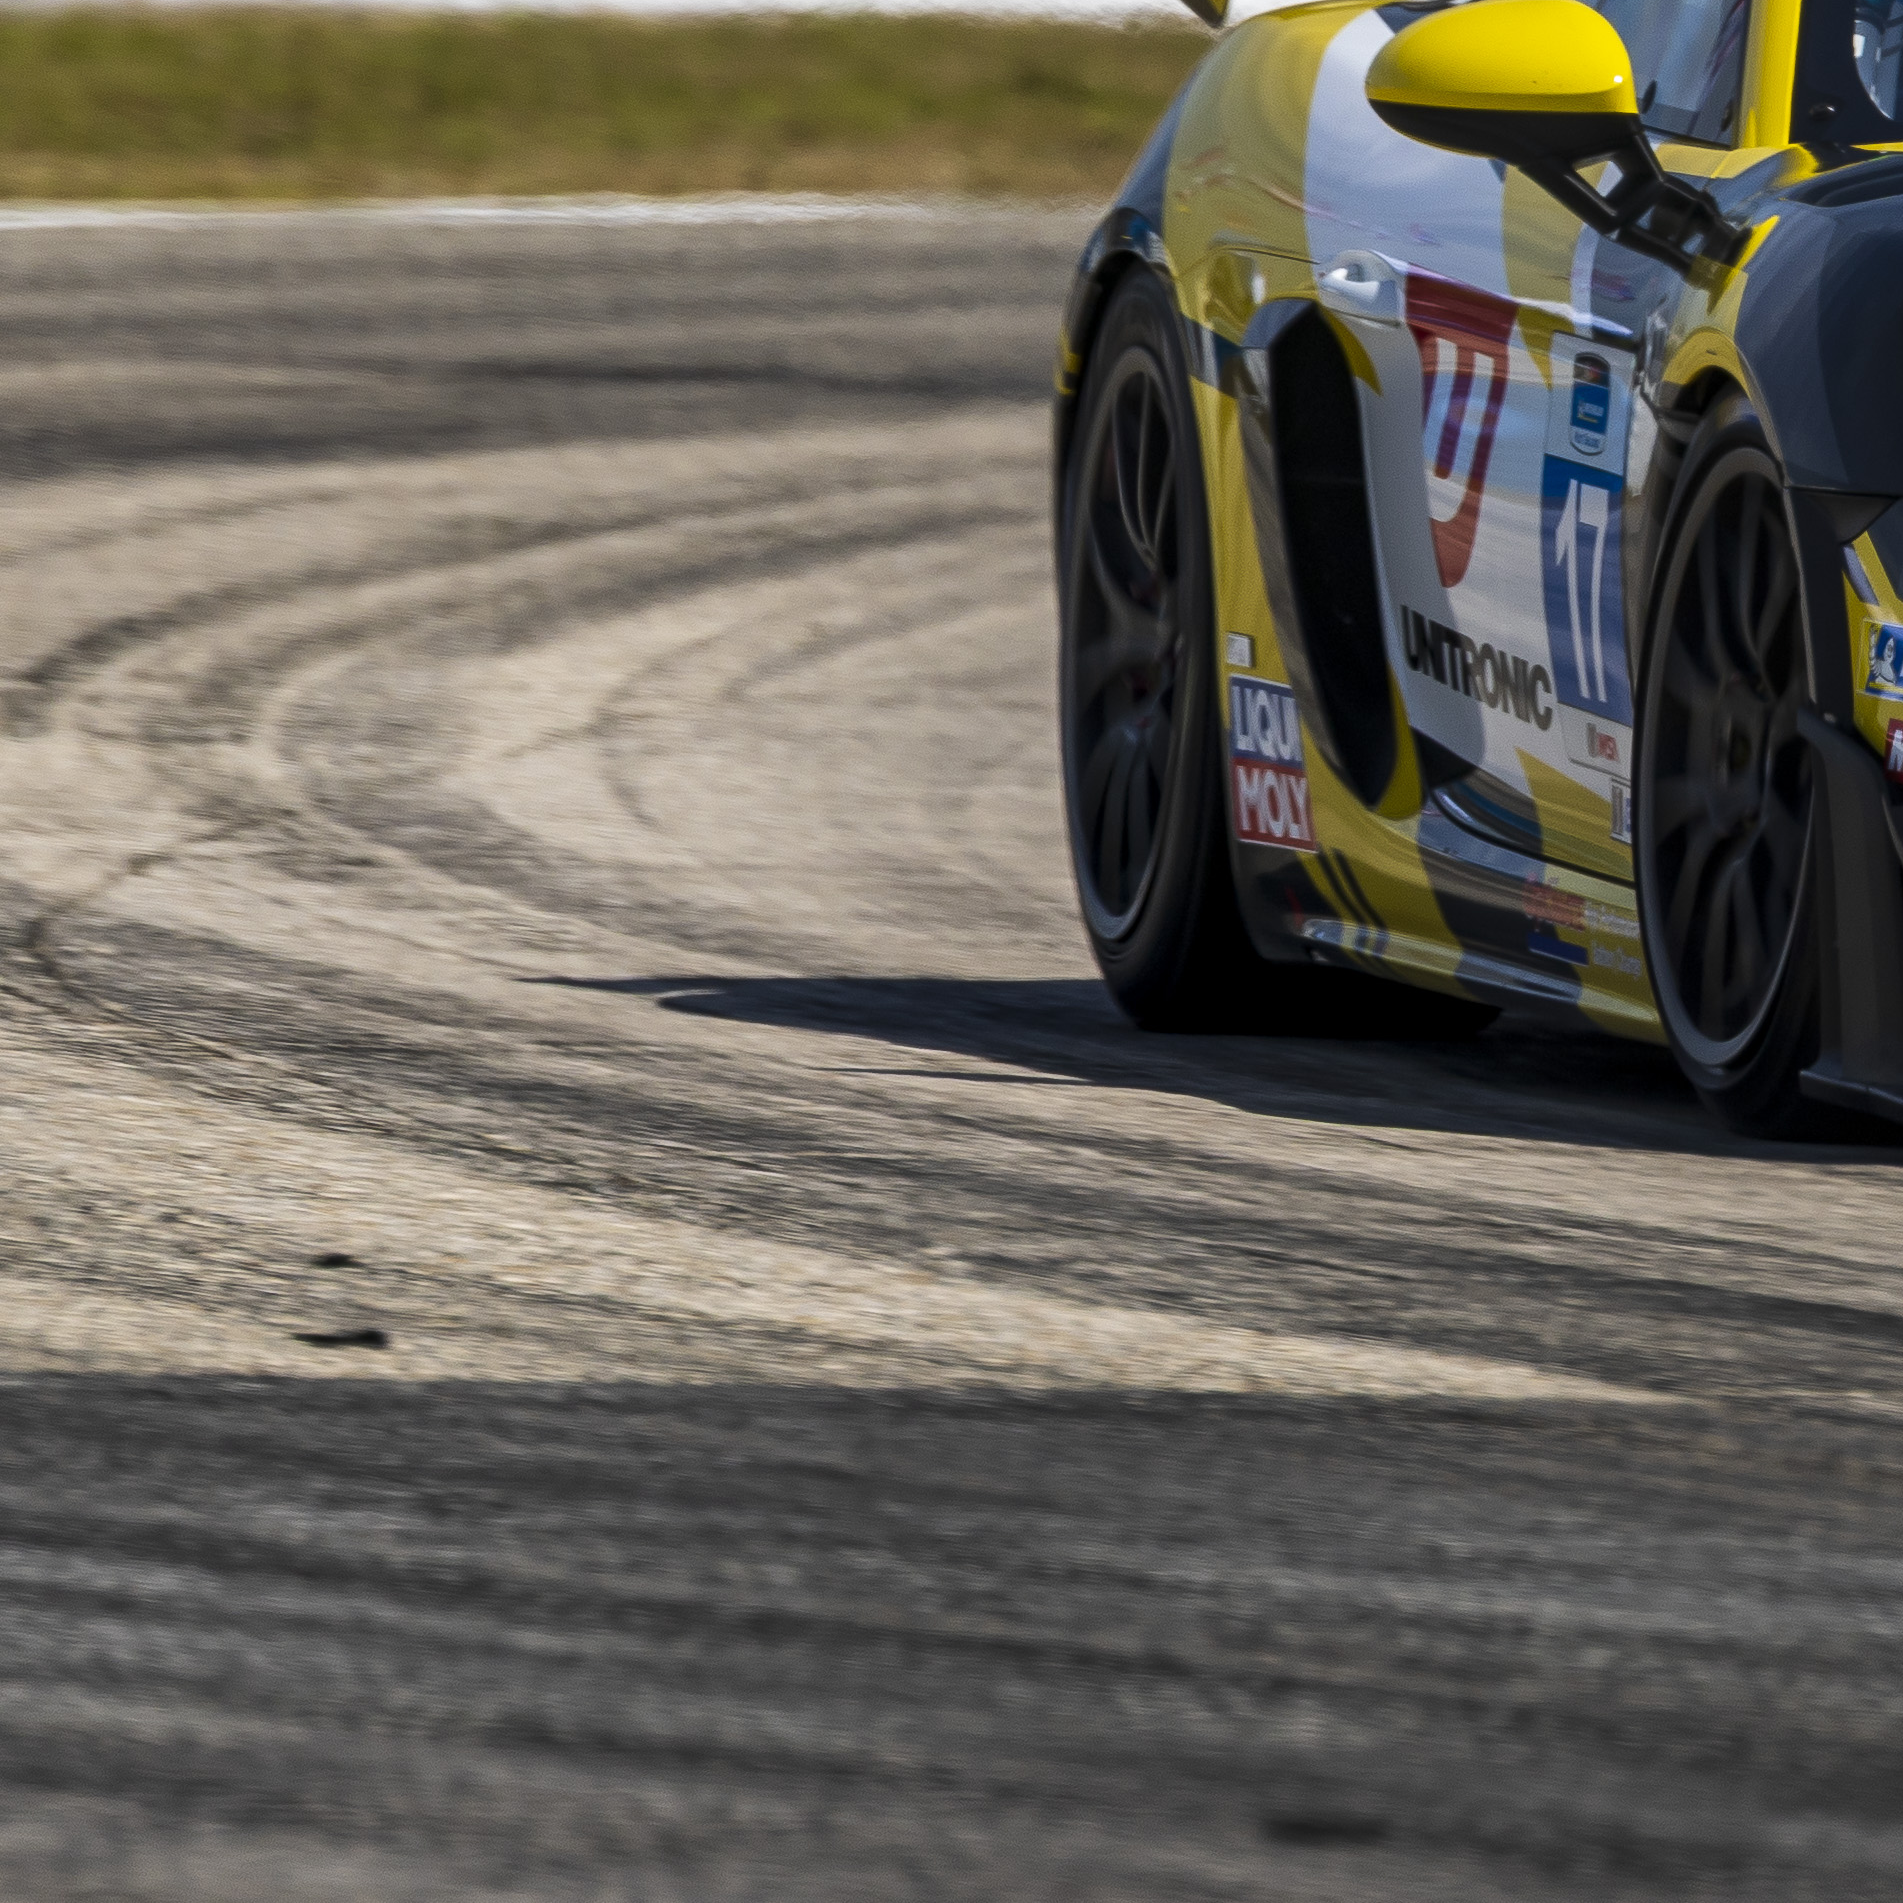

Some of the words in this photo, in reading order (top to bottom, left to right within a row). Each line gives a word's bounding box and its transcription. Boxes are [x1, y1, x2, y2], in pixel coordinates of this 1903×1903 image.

[1555, 478, 1610, 703] 17
[1401, 603, 1553, 732] UNITRONIC
[1231, 684, 1304, 764] LIQUI
[1236, 764, 1314, 842] MOLY
